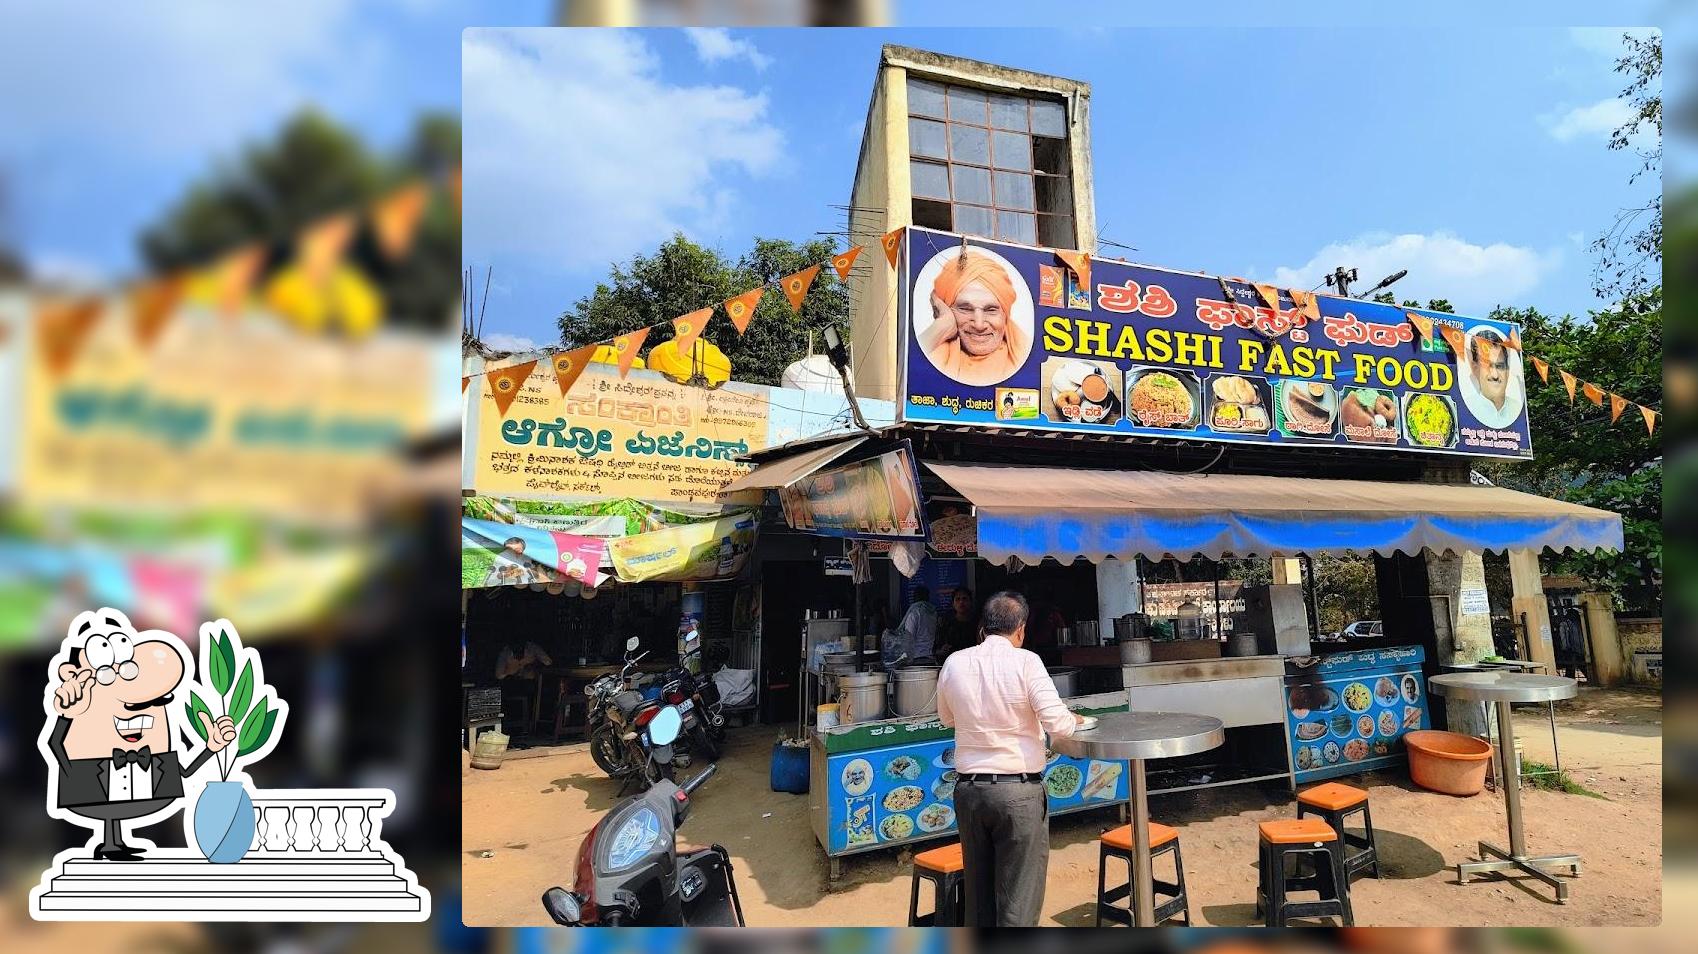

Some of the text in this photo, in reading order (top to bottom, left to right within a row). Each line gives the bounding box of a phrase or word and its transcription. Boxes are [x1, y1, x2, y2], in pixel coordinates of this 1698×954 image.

[1097, 280, 1177, 318] ಶಶಿ
[1324, 313, 1412, 347] ಫುಡ್
[1043, 315, 1453, 391] SHASHI FAST FOOD
[965, 397, 994, 410] ರುಚಿಕರ
[501, 417, 612, 457] ಆಗ್ರೋ
